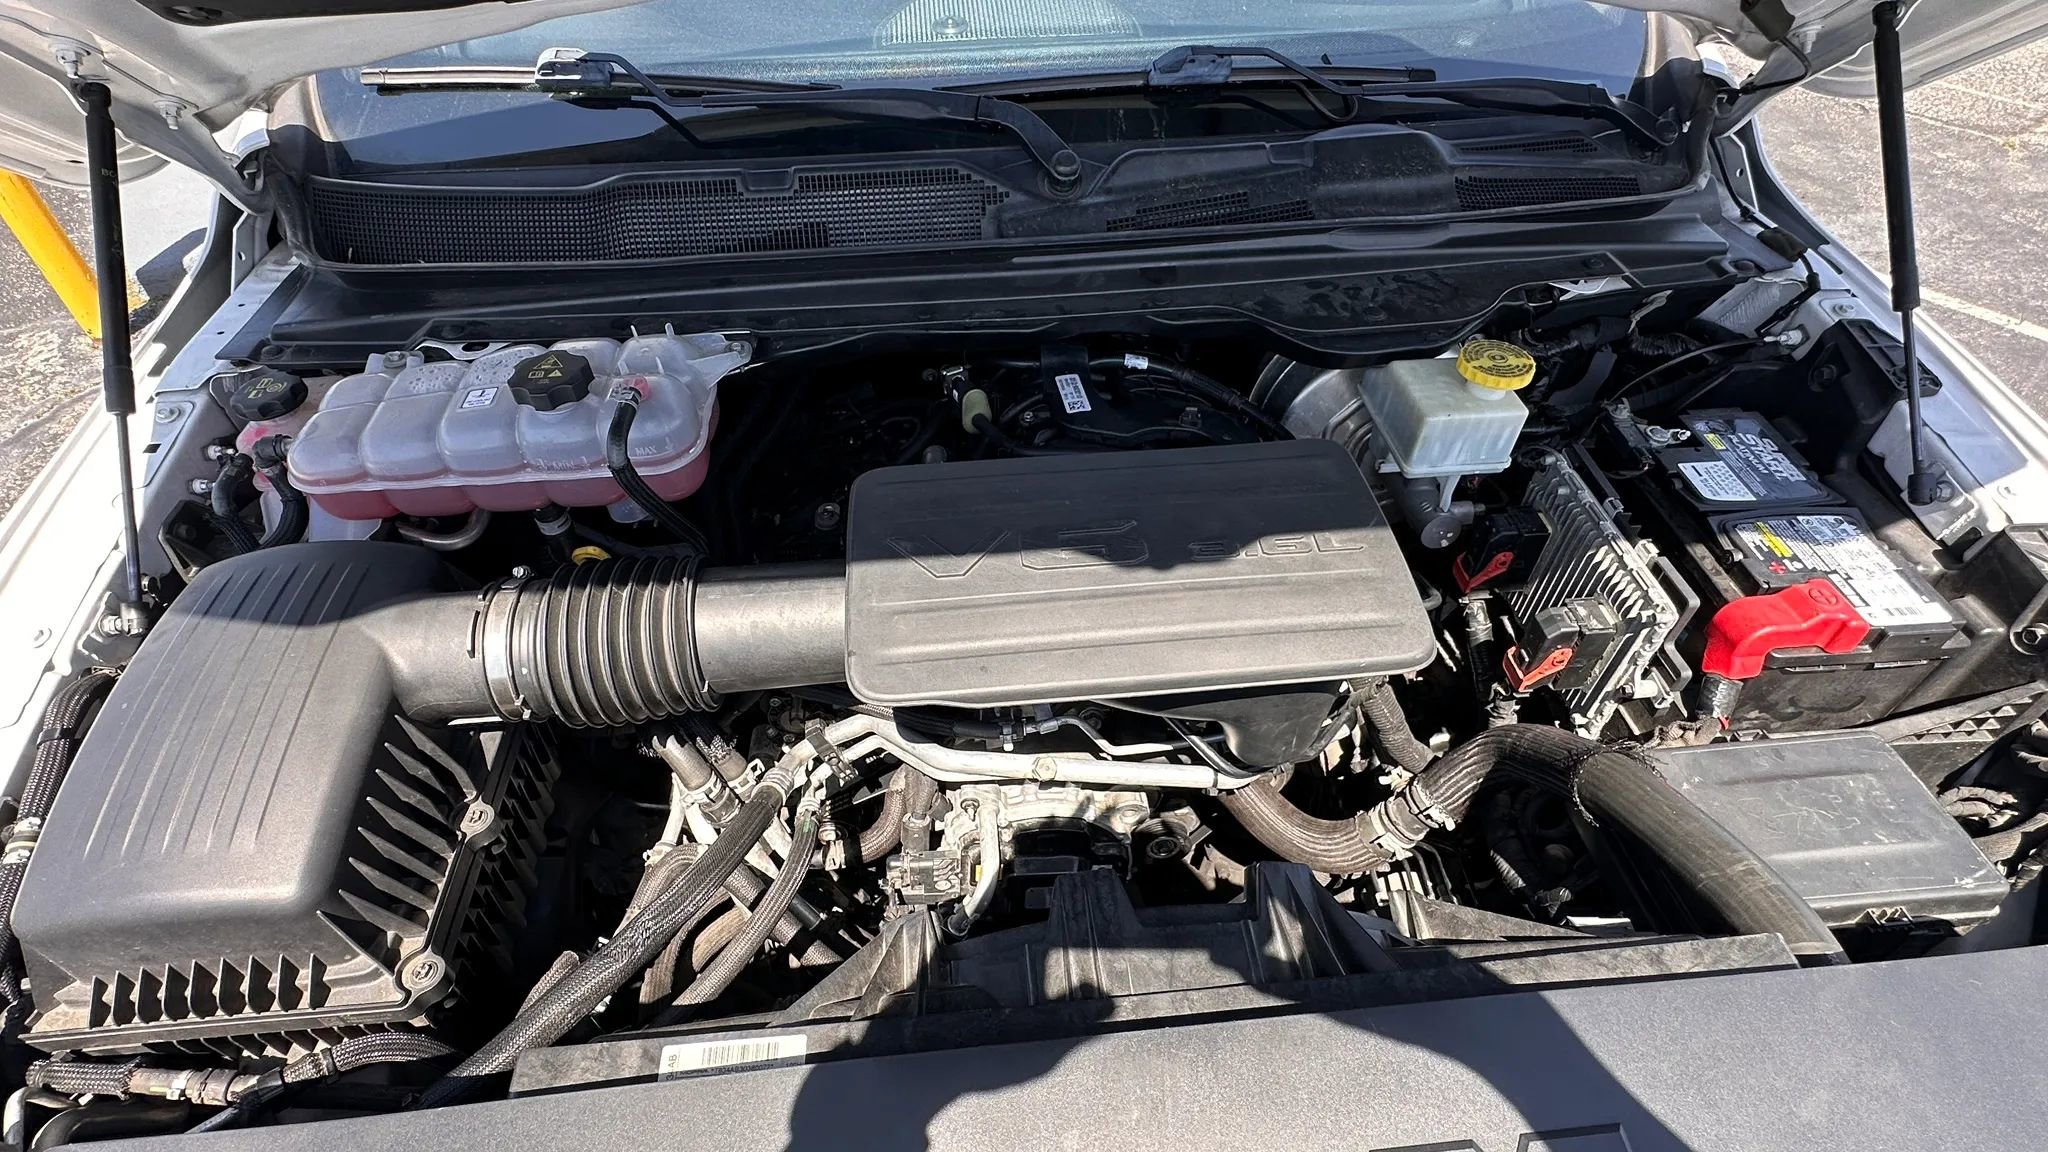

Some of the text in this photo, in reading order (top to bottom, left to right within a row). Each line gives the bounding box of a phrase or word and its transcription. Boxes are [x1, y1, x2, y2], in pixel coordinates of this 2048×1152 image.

[634, 446, 657, 456] MAX
[1727, 434, 1769, 473] PLATINUM
[1738, 433, 1787, 480] START
[1762, 438, 1806, 481] SUPER
[887, 520, 1365, 579] V6 3.6L
